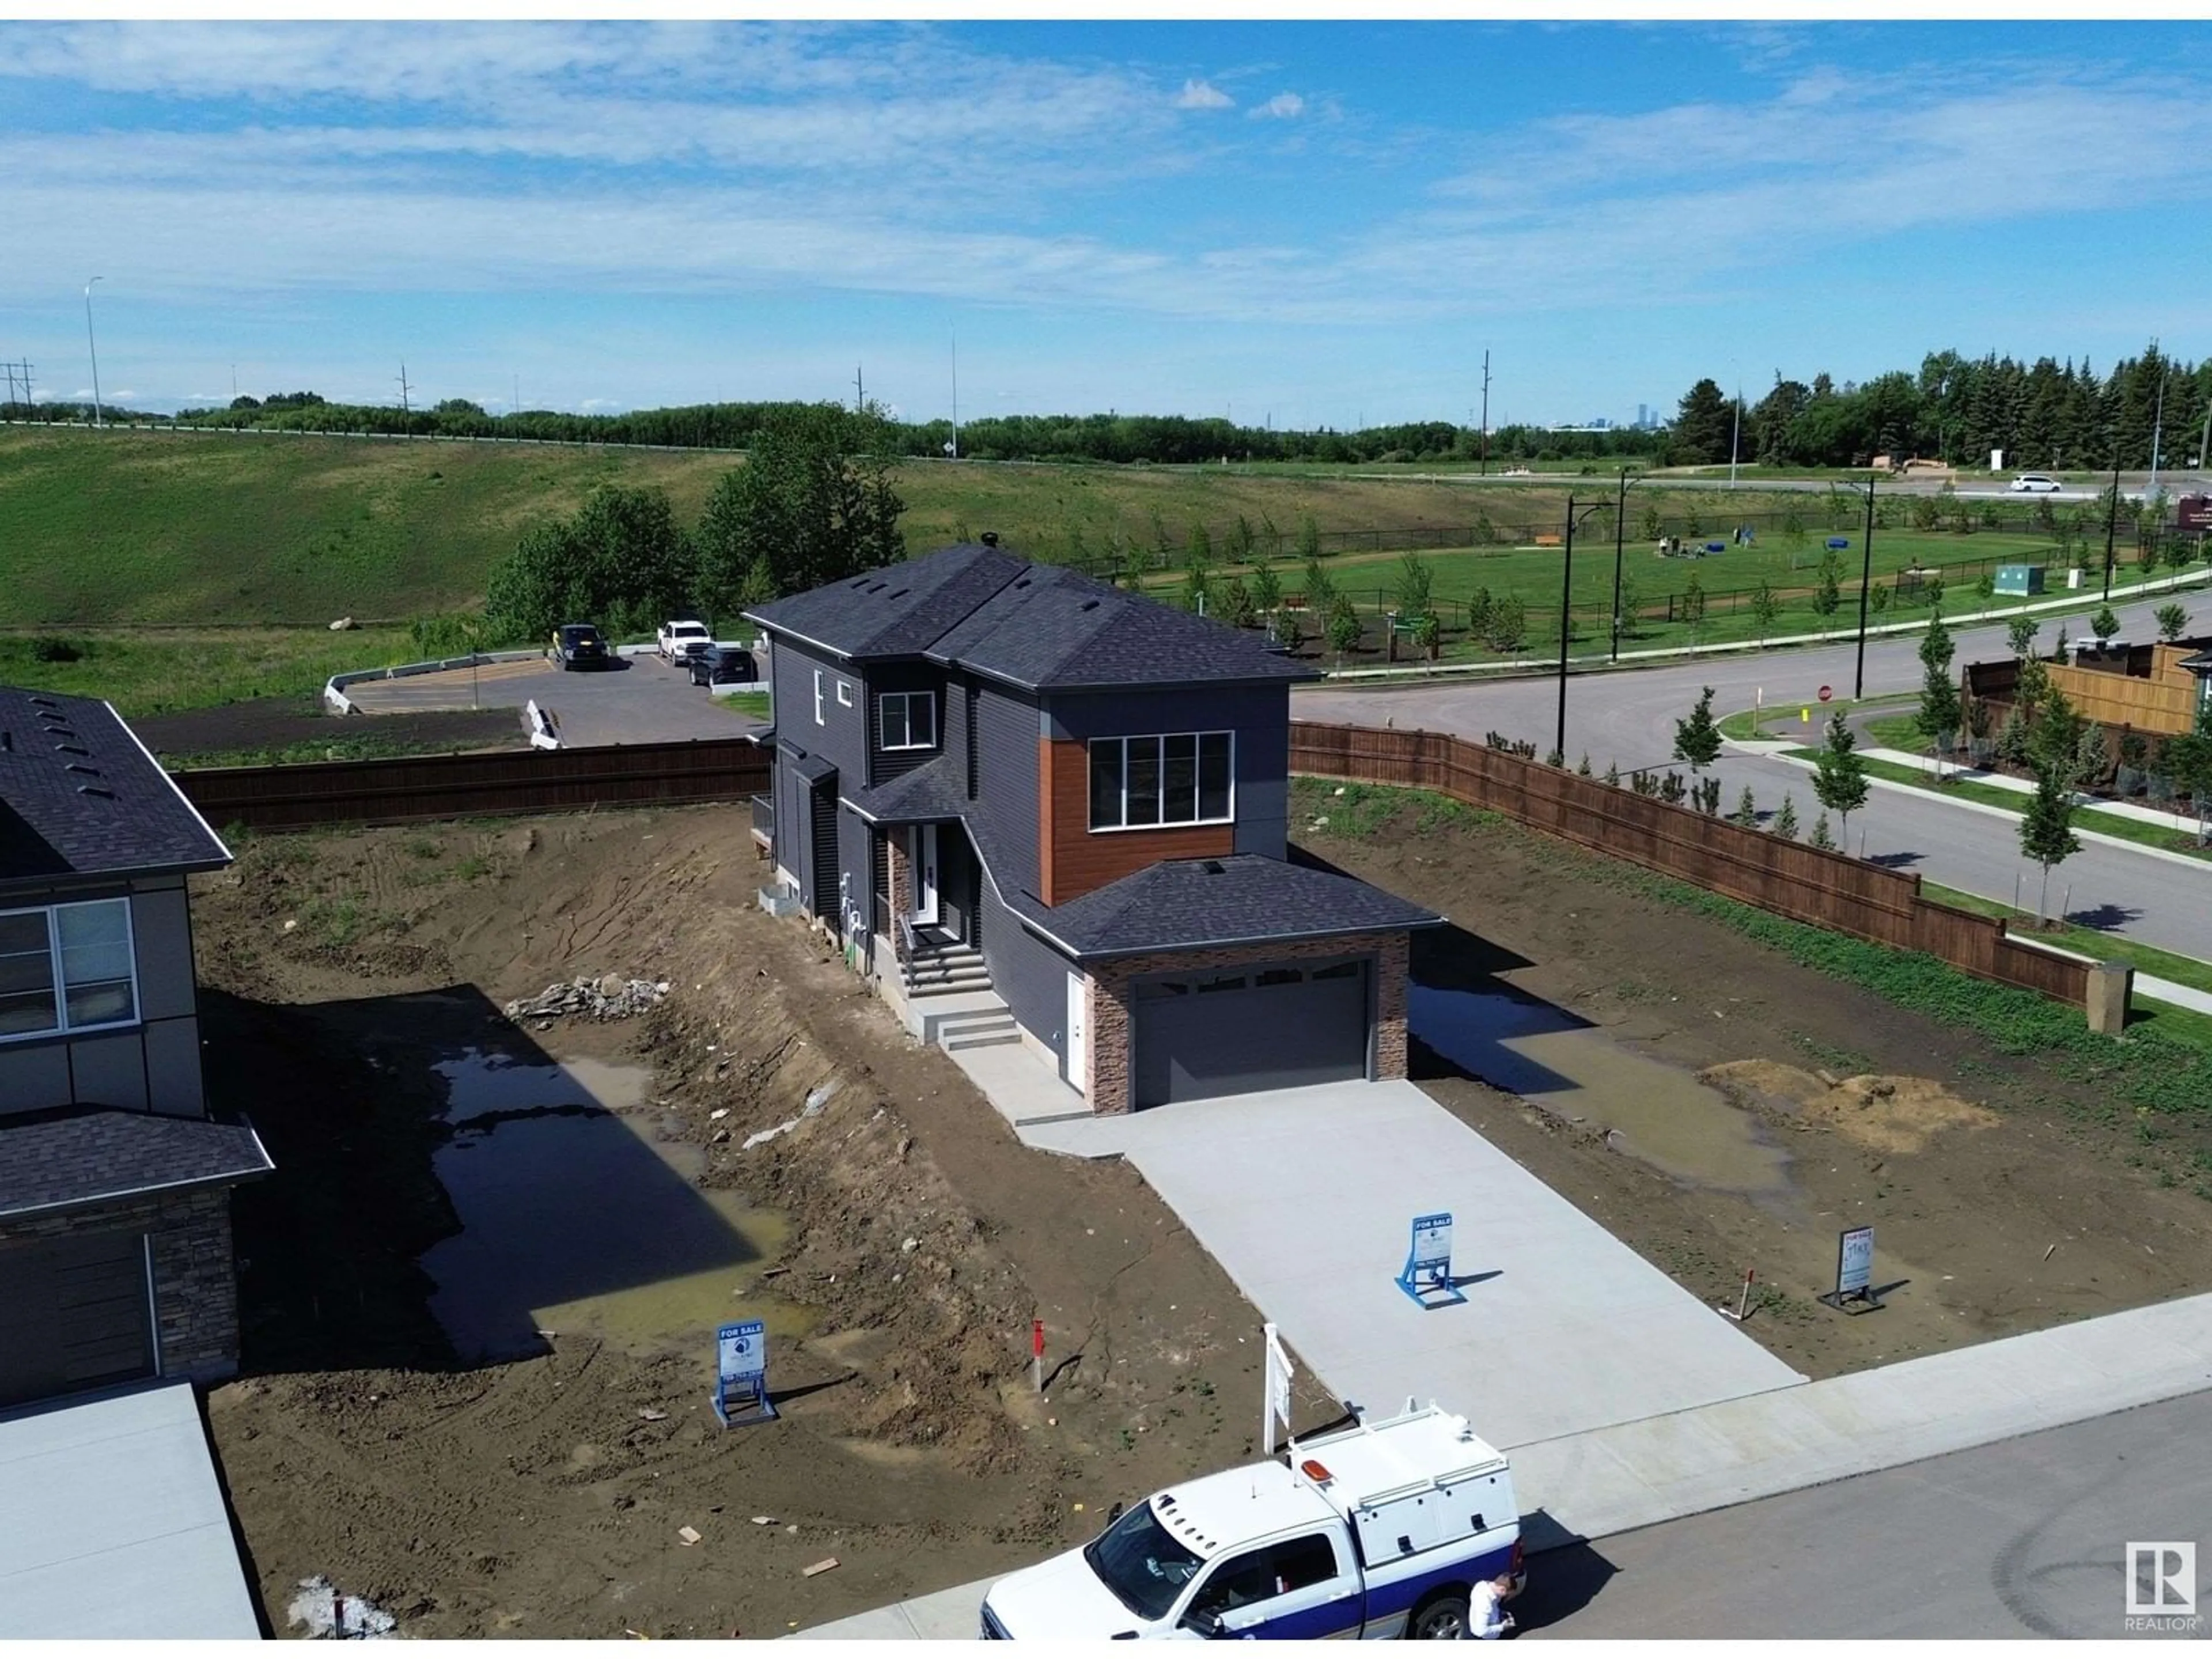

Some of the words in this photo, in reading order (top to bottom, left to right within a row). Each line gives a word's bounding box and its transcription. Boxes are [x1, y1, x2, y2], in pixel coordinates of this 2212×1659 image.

[1416, 1221, 1431, 1229] FOR
[1433, 1218, 1450, 1226] SALE
[721, 1328, 739, 1338] FOR
[740, 1324, 762, 1335] SALE
